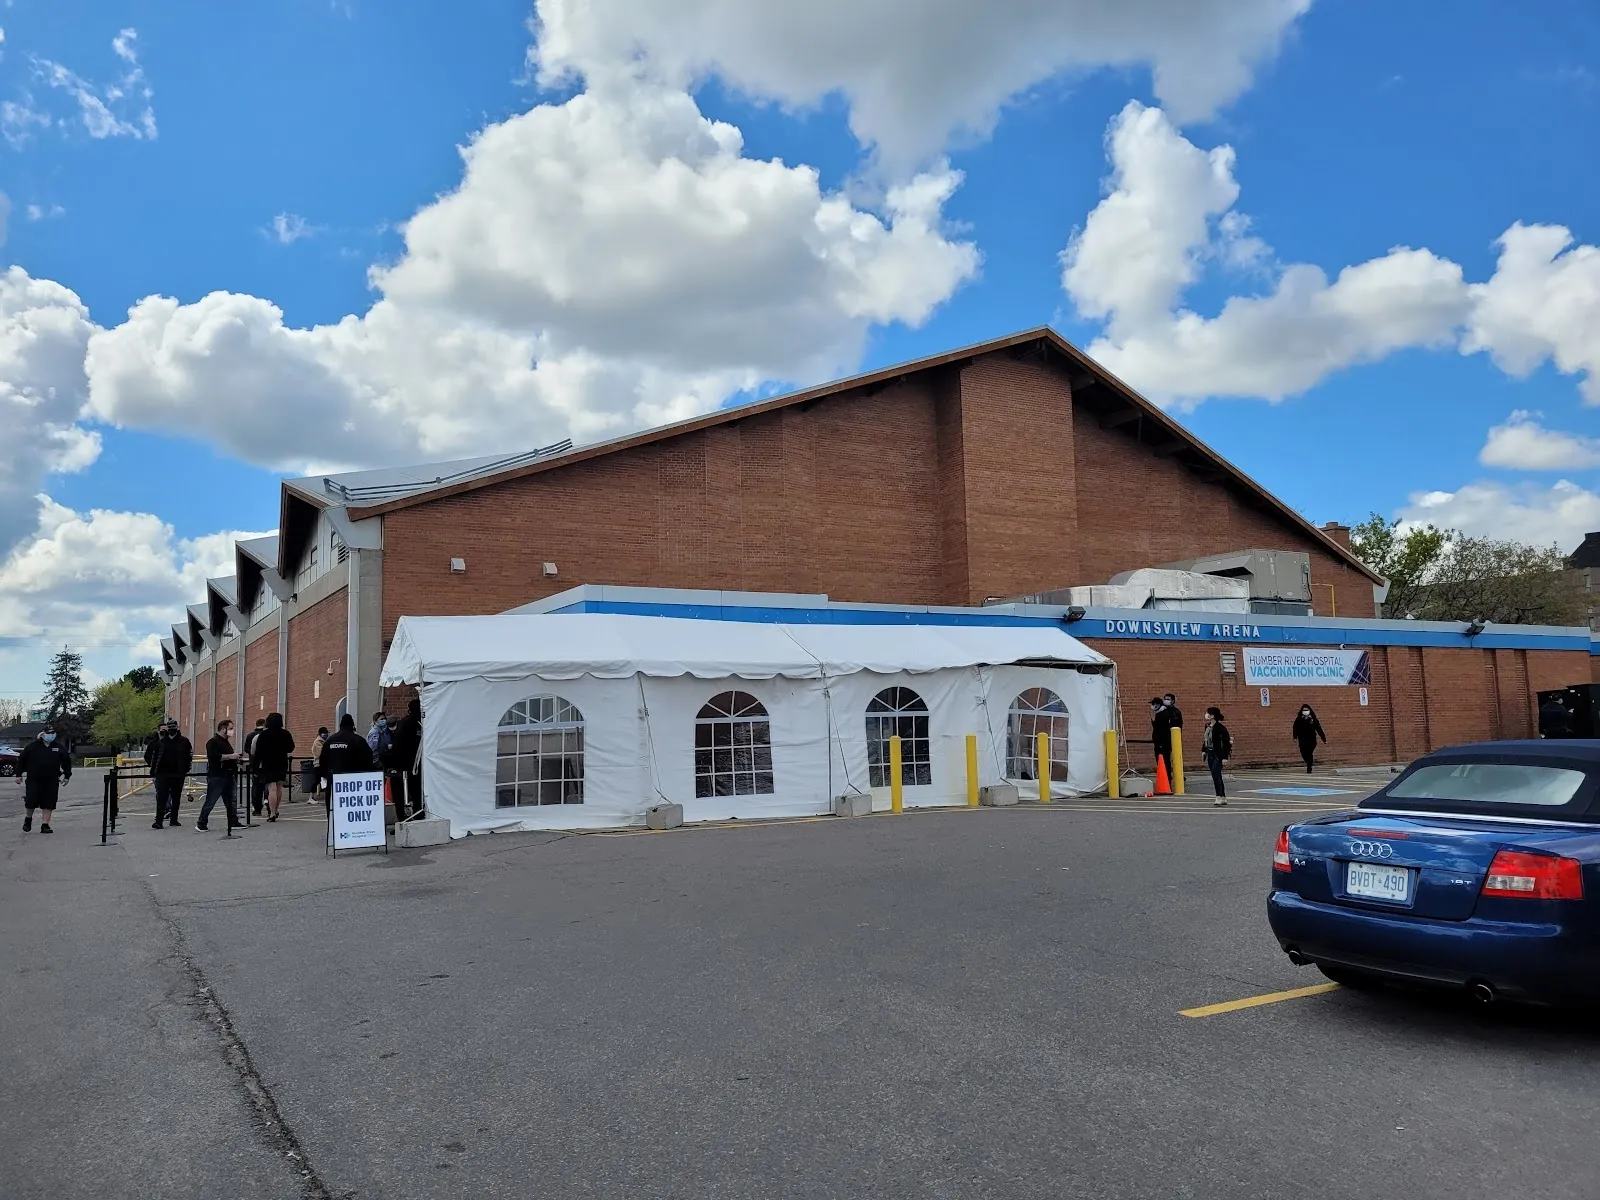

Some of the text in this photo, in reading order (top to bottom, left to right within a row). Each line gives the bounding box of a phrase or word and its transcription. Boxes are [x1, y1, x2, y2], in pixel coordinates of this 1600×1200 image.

[1105, 620, 1260, 637] DOWNSVIEW ARENA
[1249, 655, 1343, 667] HUMBER RIVER HOSPITAL
[1250, 666, 1345, 678] VACCINATION CLINIC
[335, 780, 382, 793] DROP OFF
[339, 795, 380, 808] PICK UP
[347, 810, 372, 822] ONLY
[1350, 870, 1405, 892] BVBT 490
